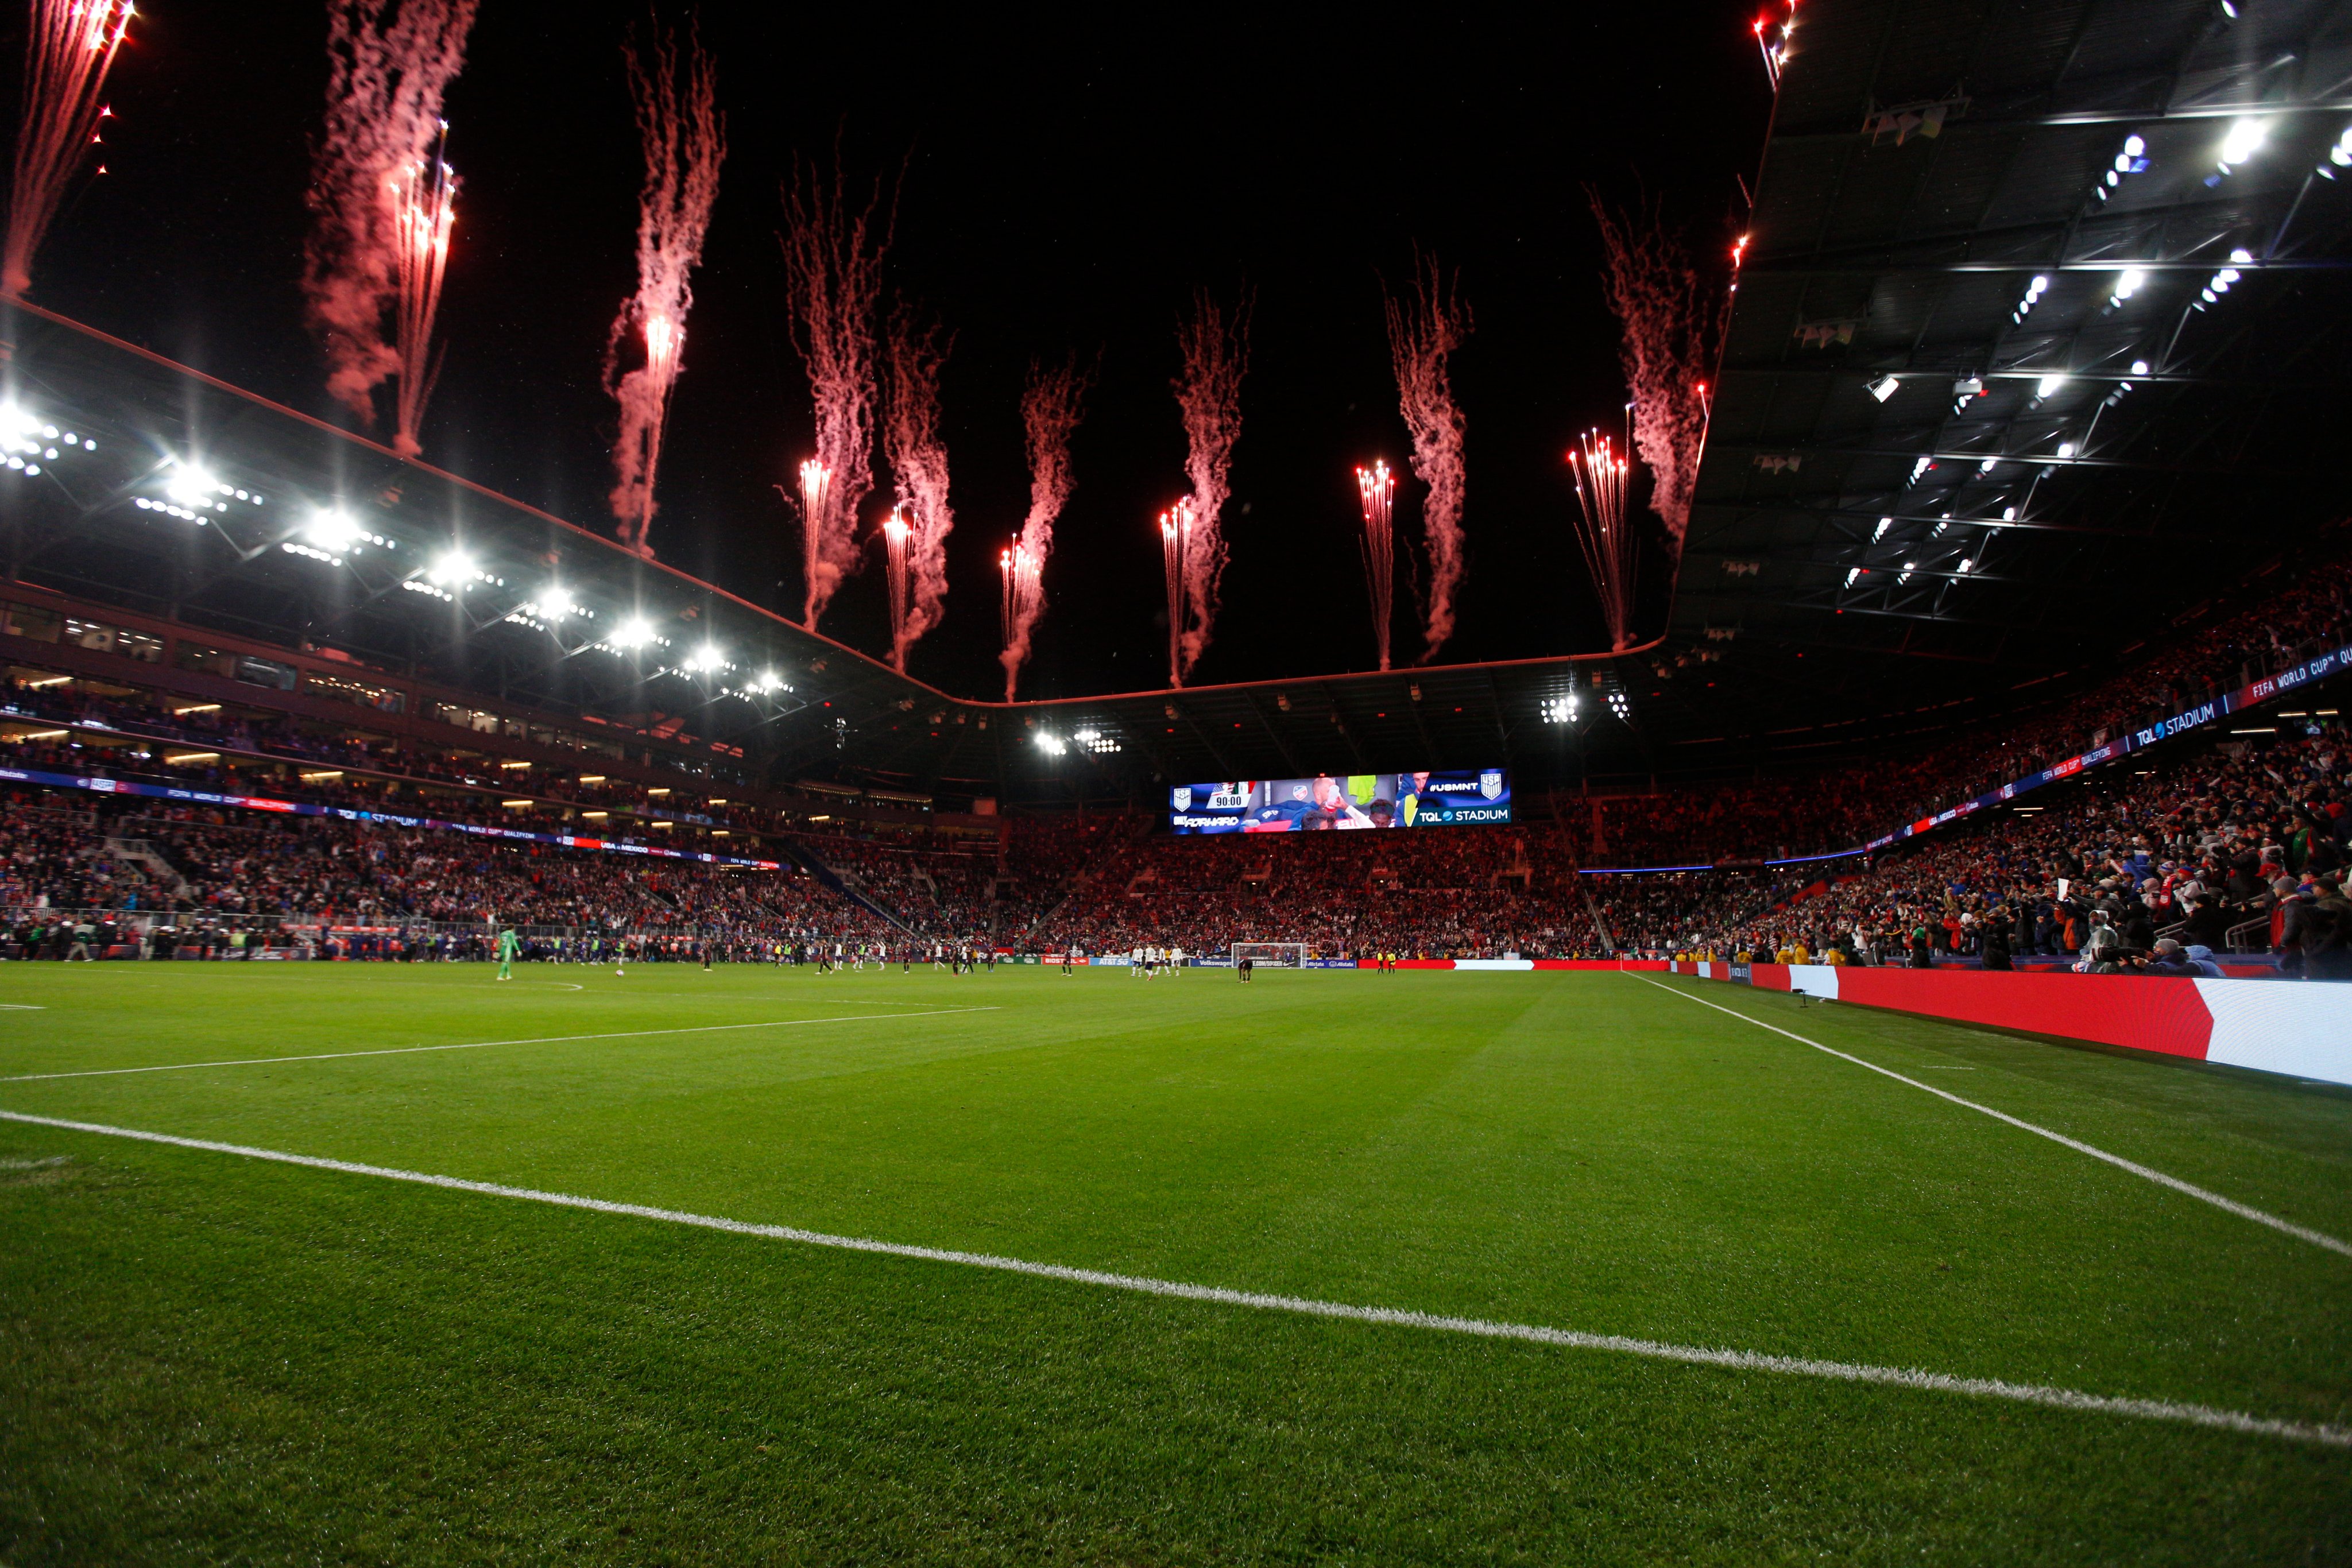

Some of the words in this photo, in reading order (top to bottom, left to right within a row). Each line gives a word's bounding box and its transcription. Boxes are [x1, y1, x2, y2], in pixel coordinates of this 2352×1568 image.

[2252, 680, 2274, 698] FIFA
[2277, 668, 2306, 688] WORLD
[2137, 728, 2157, 746] TQL
[2166, 703, 2215, 735] STADIUM
[2042, 770, 2053, 780] FIFA
[2053, 764, 2067, 776] WORLD
[2081, 747, 2111, 765] QUALIFYING
[1482, 775, 1500, 786] USA
[1430, 783, 1479, 792] #USMNT
[1175, 789, 1189, 799] USA
[1216, 796, 1241, 807] 90:00
[1419, 812, 1442, 822] TQL
[1456, 809, 1508, 821] STADIUM
[1929, 817, 1938, 826] USA
[1940, 809, 1956, 822] MEXICO
[1185, 816, 1239, 827] FORWARD
[504, 830, 536, 839] QUALIFYING
[601, 842, 616, 850] USA
[621, 845, 648, 853] MEXICO
